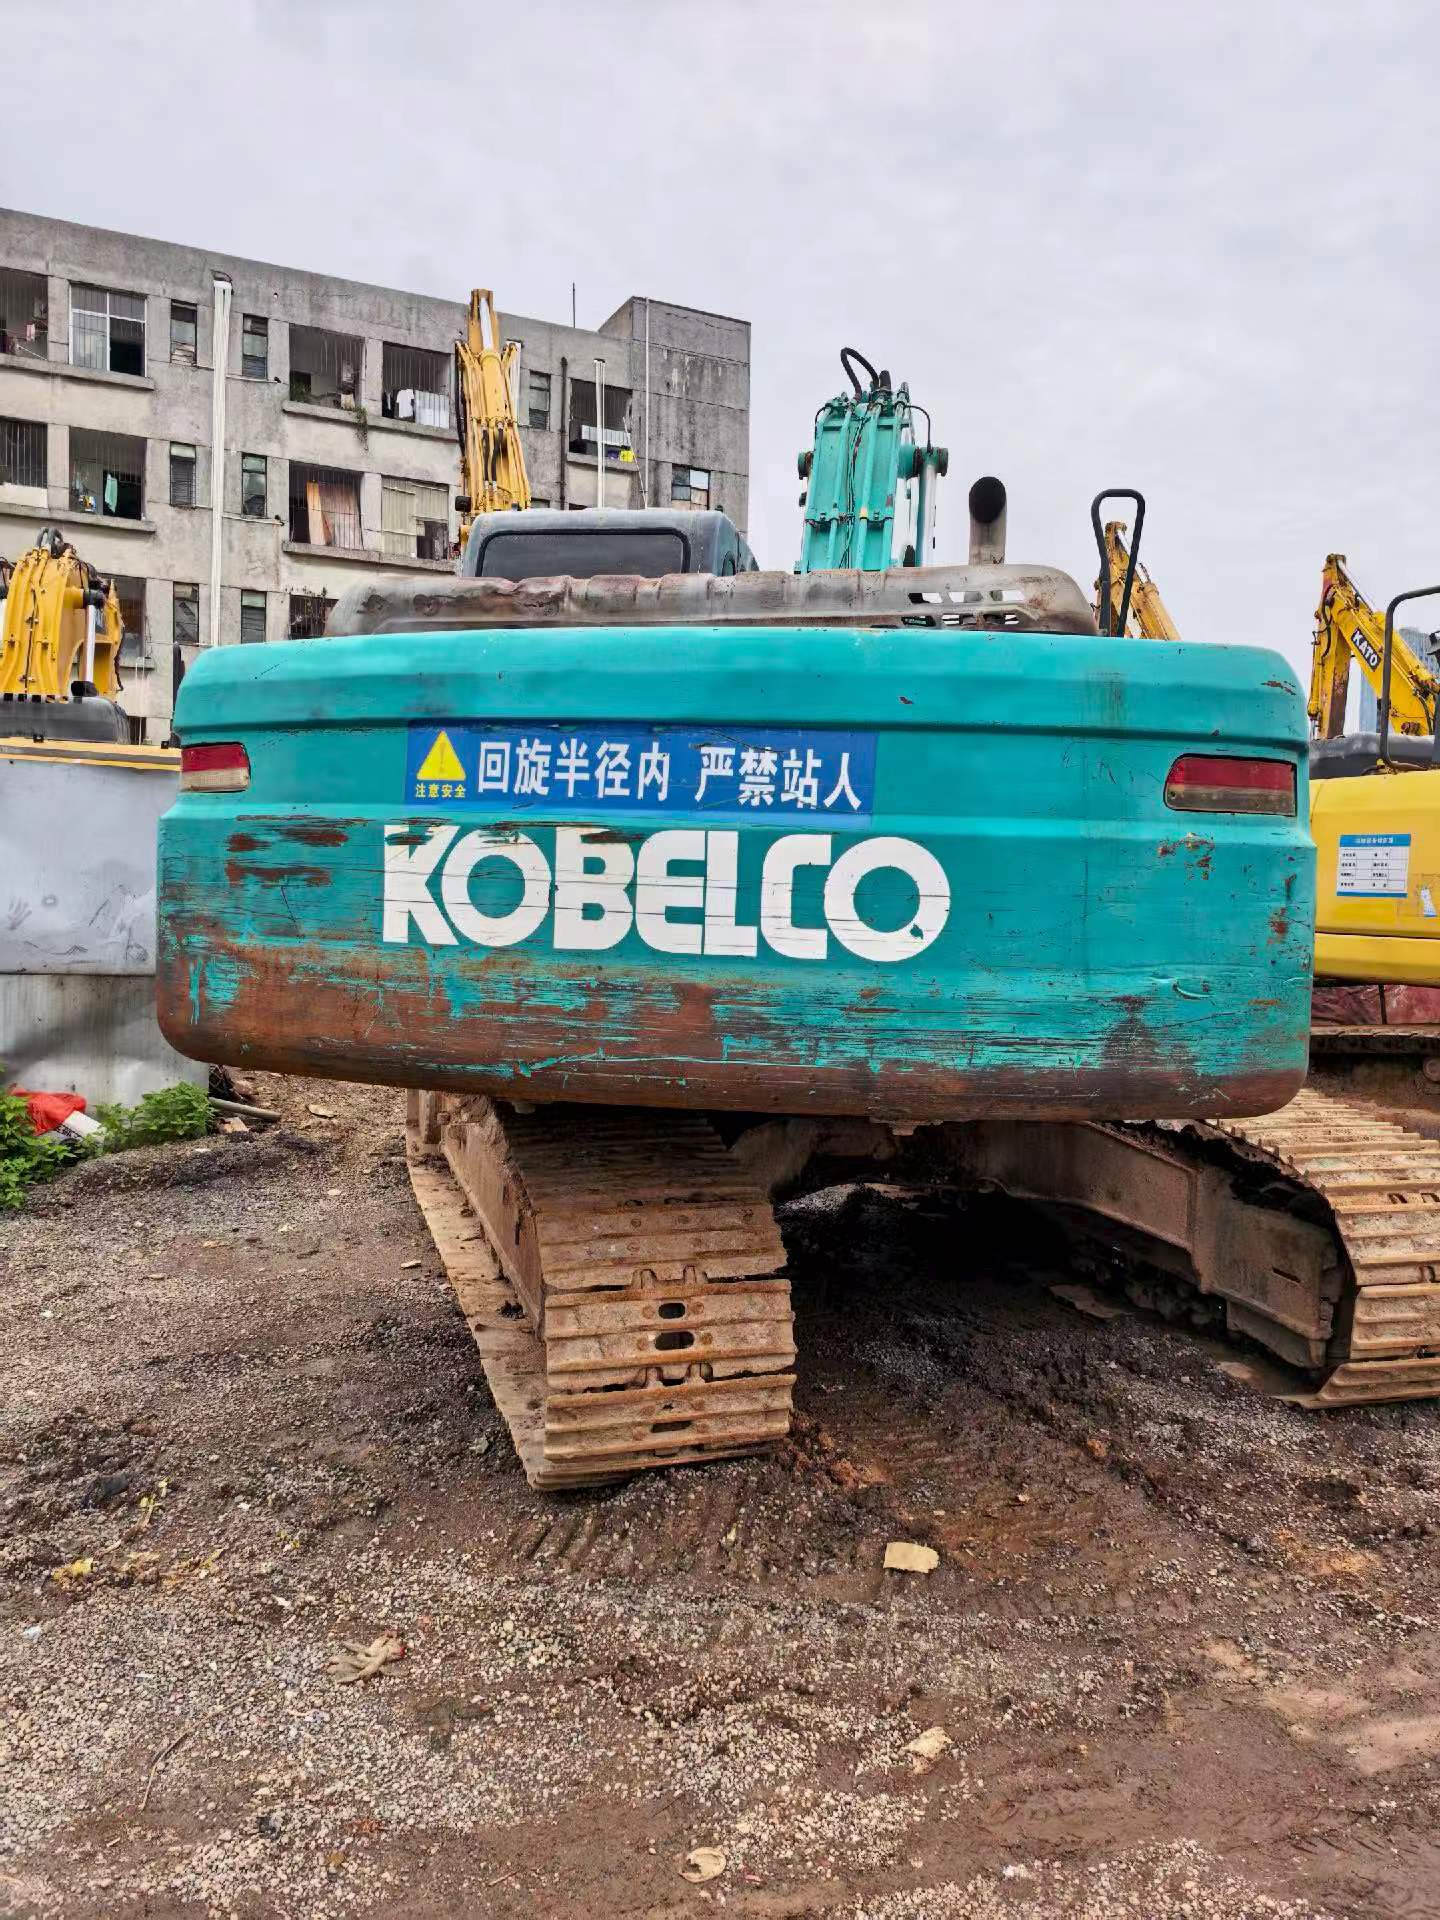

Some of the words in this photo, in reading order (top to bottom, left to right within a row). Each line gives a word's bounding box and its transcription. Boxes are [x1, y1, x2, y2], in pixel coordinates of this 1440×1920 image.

[1352, 629, 1378, 667] KATO
[415, 783, 467, 799] 注意安全
[478, 738, 670, 802] 回旋半径内
[695, 746, 862, 811] 严禁站人
[382, 824, 951, 962] KOBELCO
